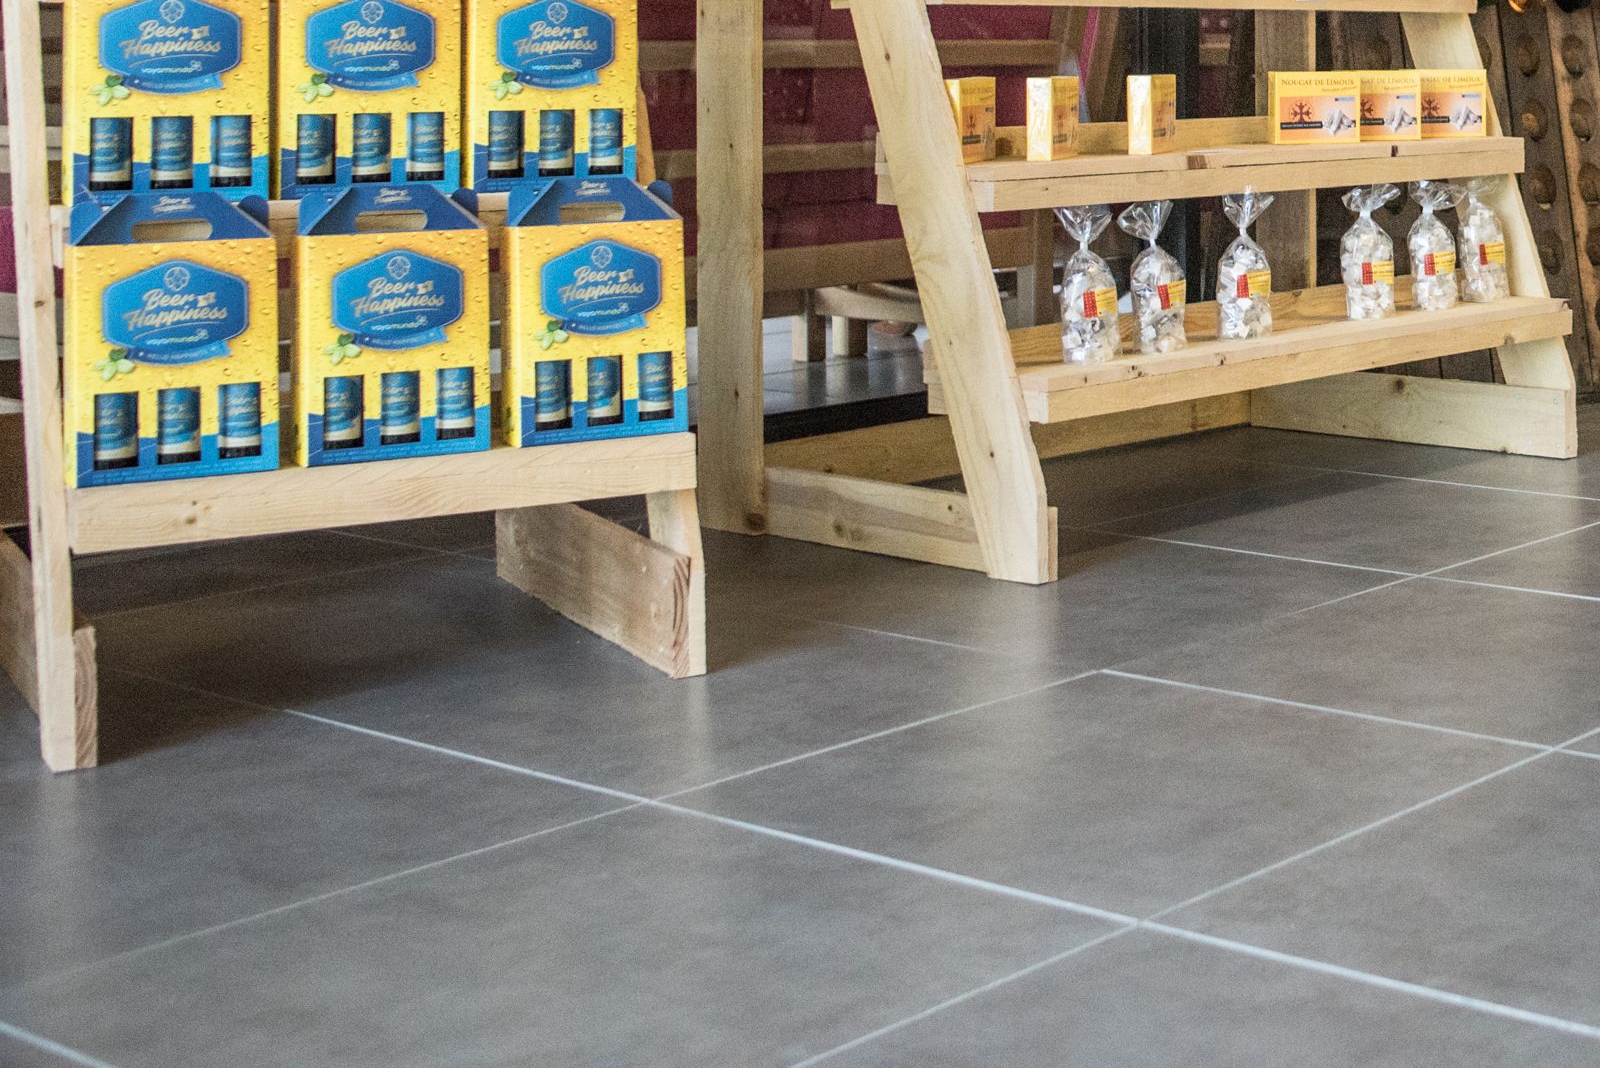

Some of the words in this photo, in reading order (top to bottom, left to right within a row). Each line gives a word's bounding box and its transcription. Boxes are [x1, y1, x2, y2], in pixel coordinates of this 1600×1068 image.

[139, 20, 190, 40] Beer
[341, 20, 389, 40] Beer
[529, 20, 573, 40] Beer
[118, 37, 221, 57] Happiness
[323, 37, 417, 57] Happiness
[513, 37, 597, 56] Happiness
[1326, 78, 1355, 86] LIMOUX
[1388, 76, 1415, 85] LIMOUX
[1453, 74, 1480, 82] LIMOUX
[573, 265, 617, 285] Beer
[368, 277, 417, 297] Beer
[558, 282, 645, 303] Happiness
[143, 288, 197, 309] Beer
[350, 294, 444, 318] Happiness
[122, 305, 228, 332] Happiness
